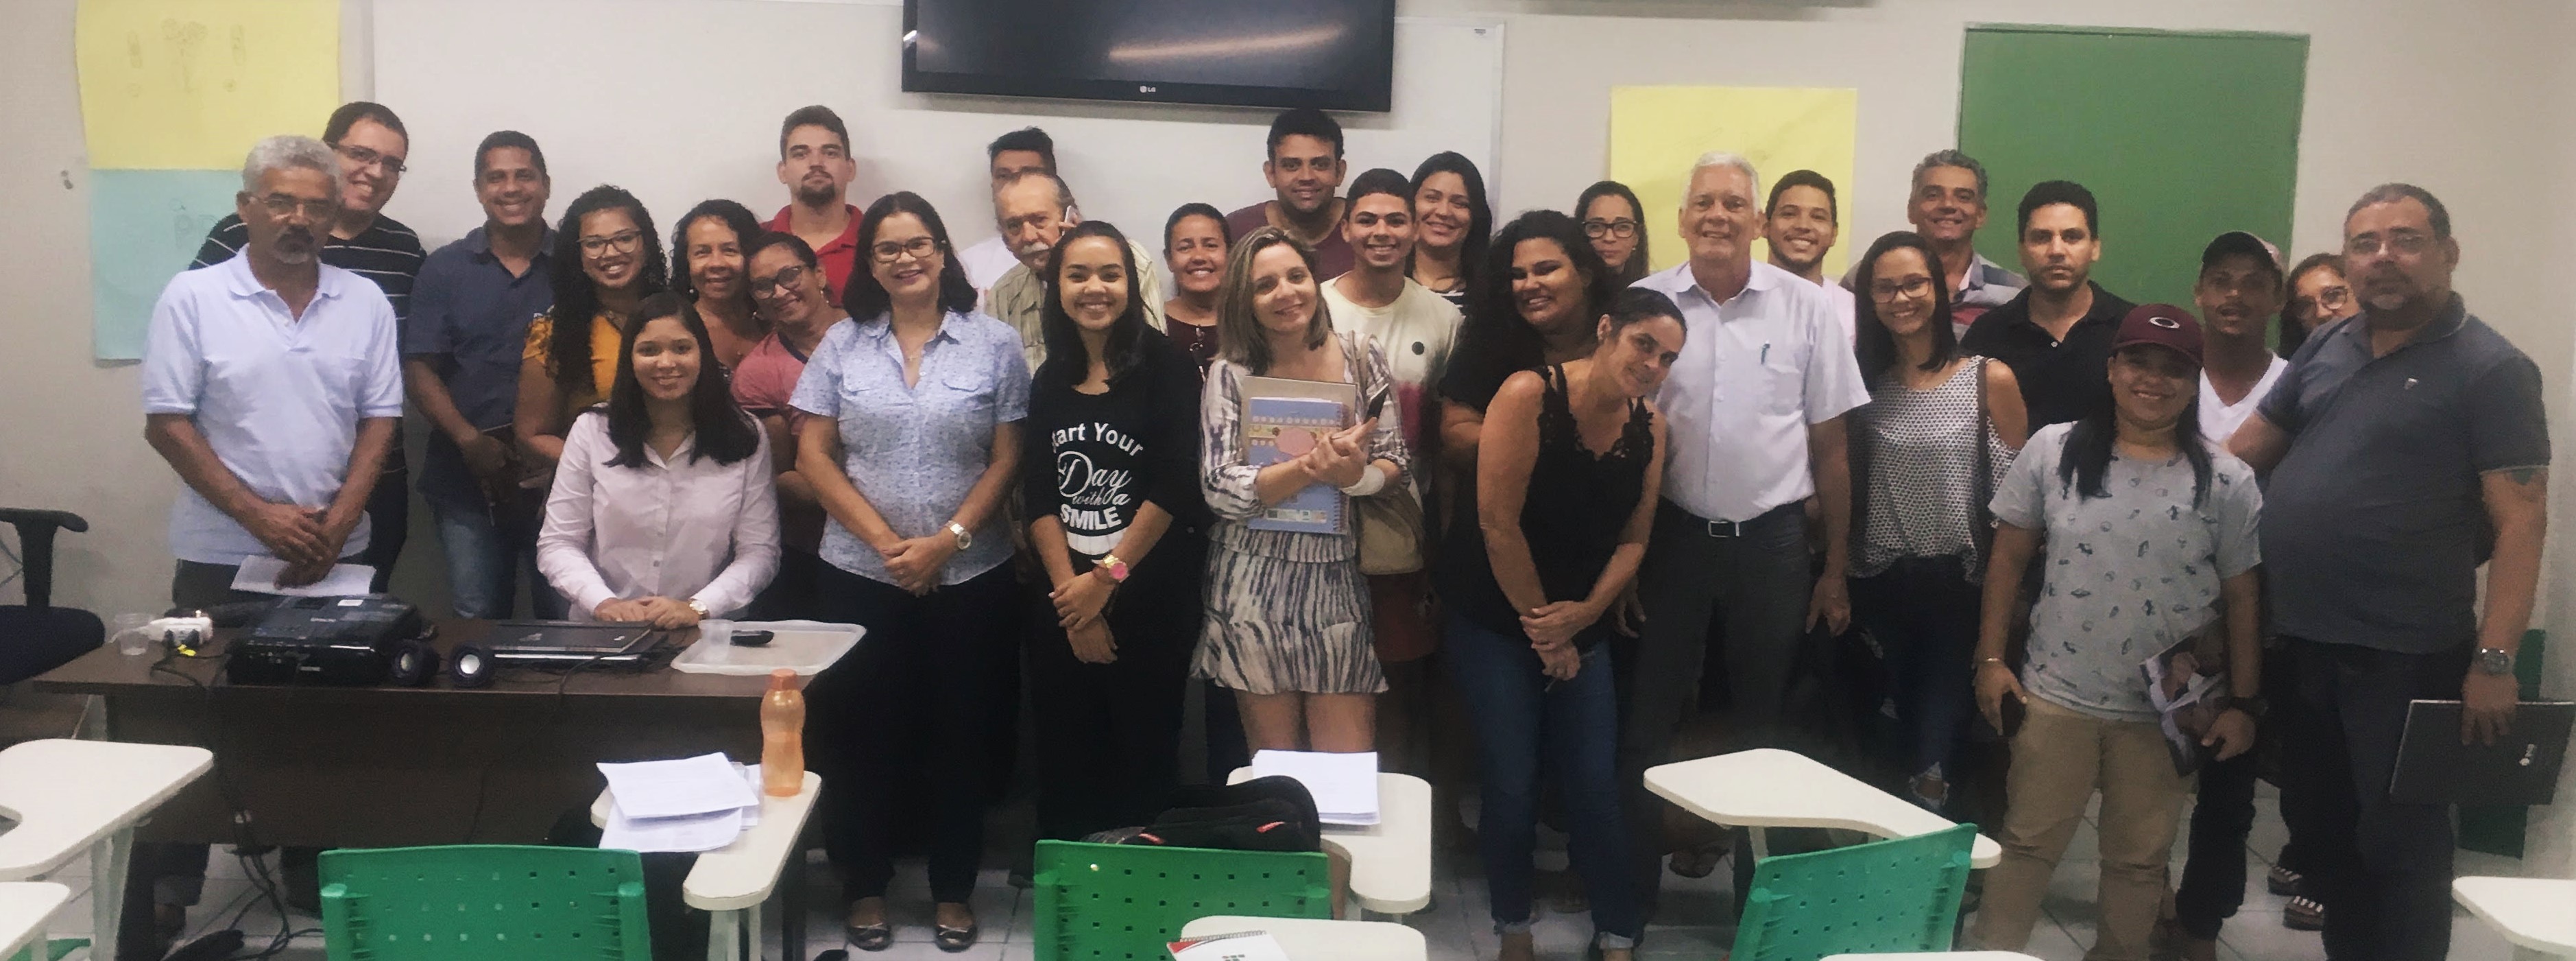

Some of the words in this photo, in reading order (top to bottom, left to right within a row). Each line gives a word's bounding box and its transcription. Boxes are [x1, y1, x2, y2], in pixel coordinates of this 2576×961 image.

[1051, 423, 1086, 453] tart
[1094, 422, 1144, 456] Your
[1057, 451, 1132, 505] Day
[1072, 488, 1105, 505] with
[1111, 493, 1131, 506] a
[1060, 503, 1122, 530] SMILE
